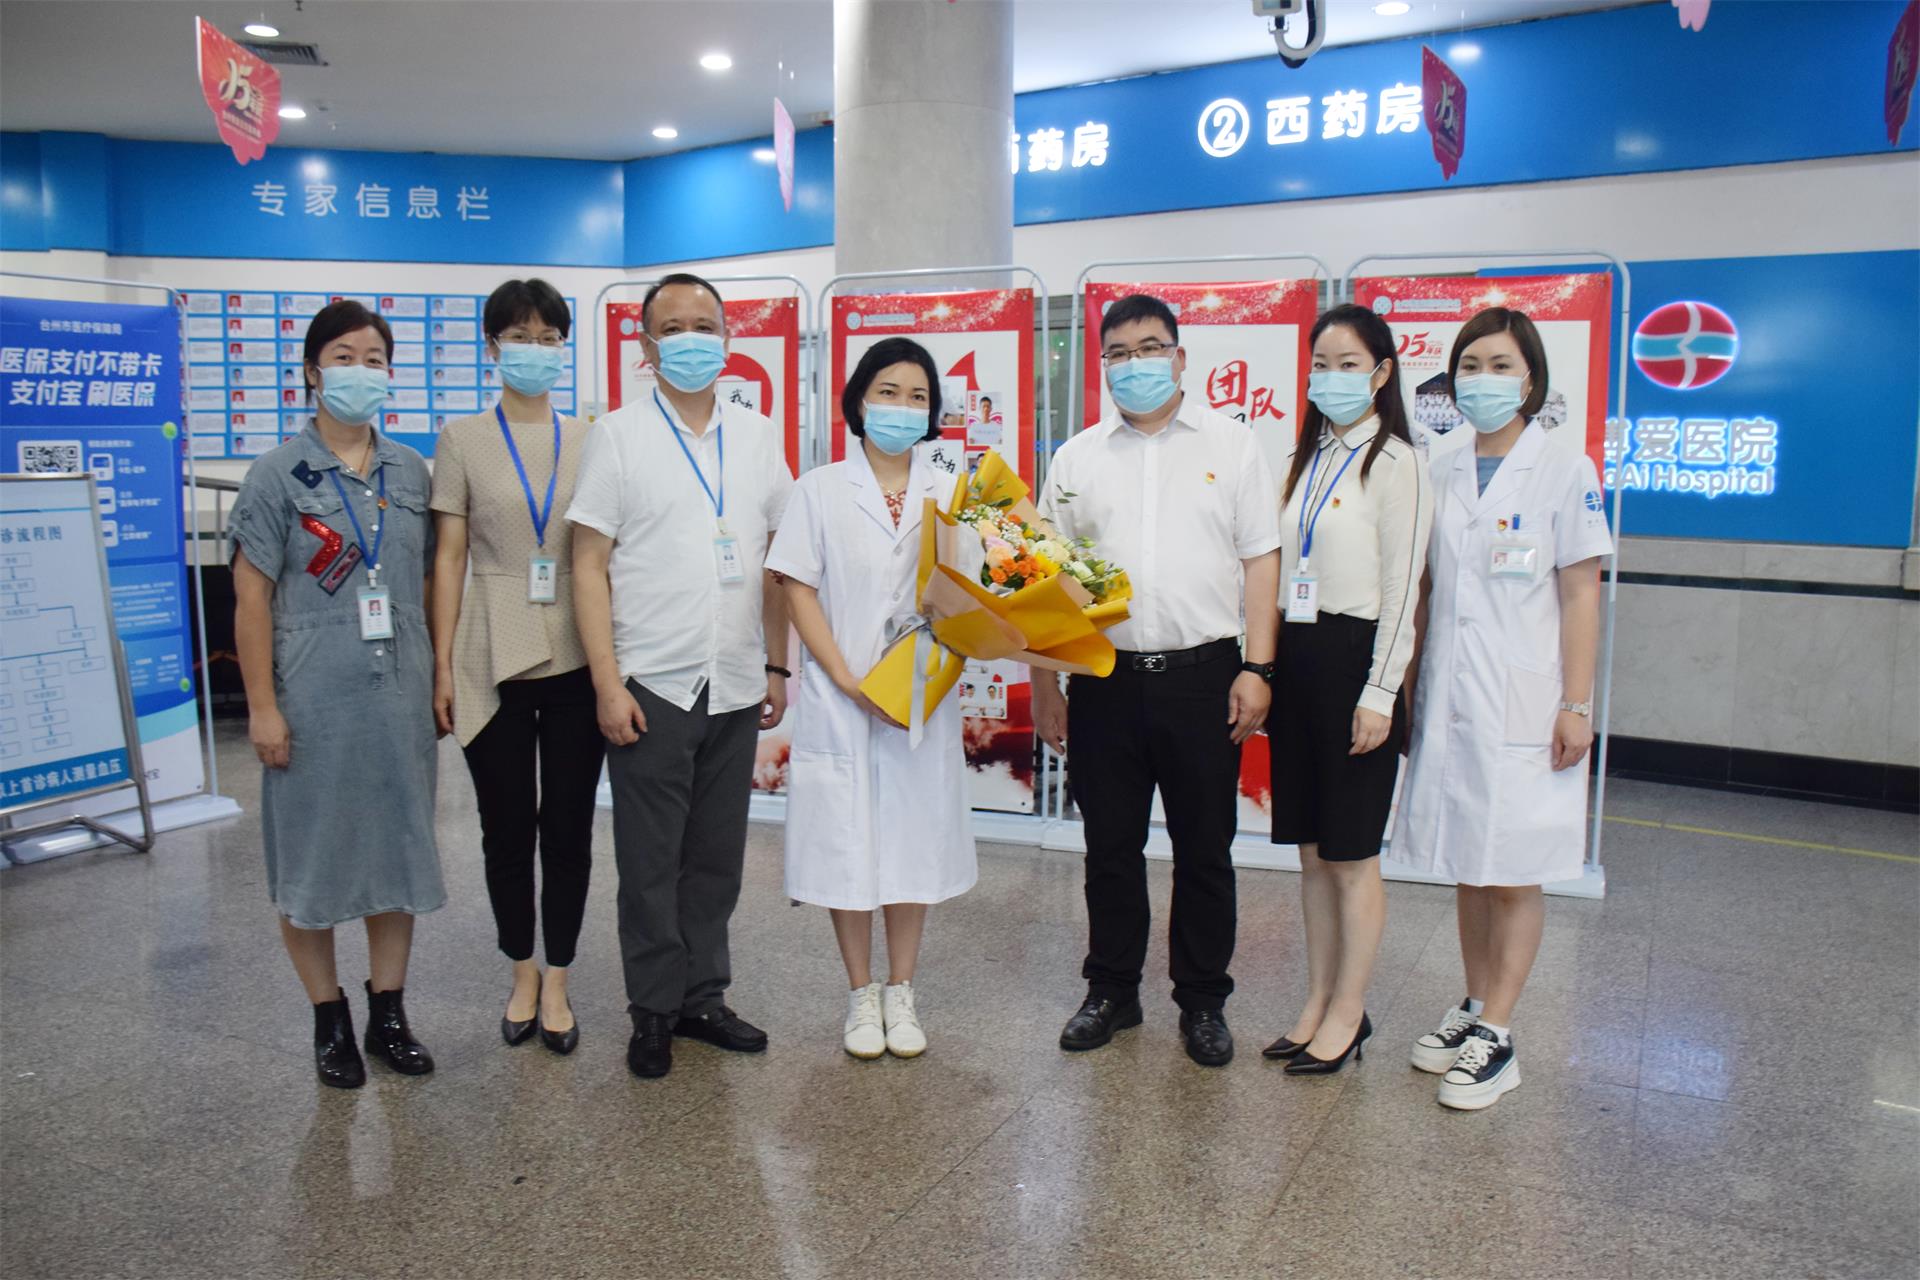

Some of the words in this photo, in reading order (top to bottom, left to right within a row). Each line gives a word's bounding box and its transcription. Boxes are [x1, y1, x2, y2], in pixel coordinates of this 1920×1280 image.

[1265, 82, 1423, 146] 西药房
[251, 180, 491, 222] 专家信息栏
[40, 318, 123, 336] 台州市医疗保障局
[0, 347, 163, 378] 医保支付不带卡
[8, 378, 84, 406] 支付宝
[86, 380, 157, 407] 刷医保
[1206, 359, 1287, 421] 团队
[1651, 463, 1776, 499] Hospital
